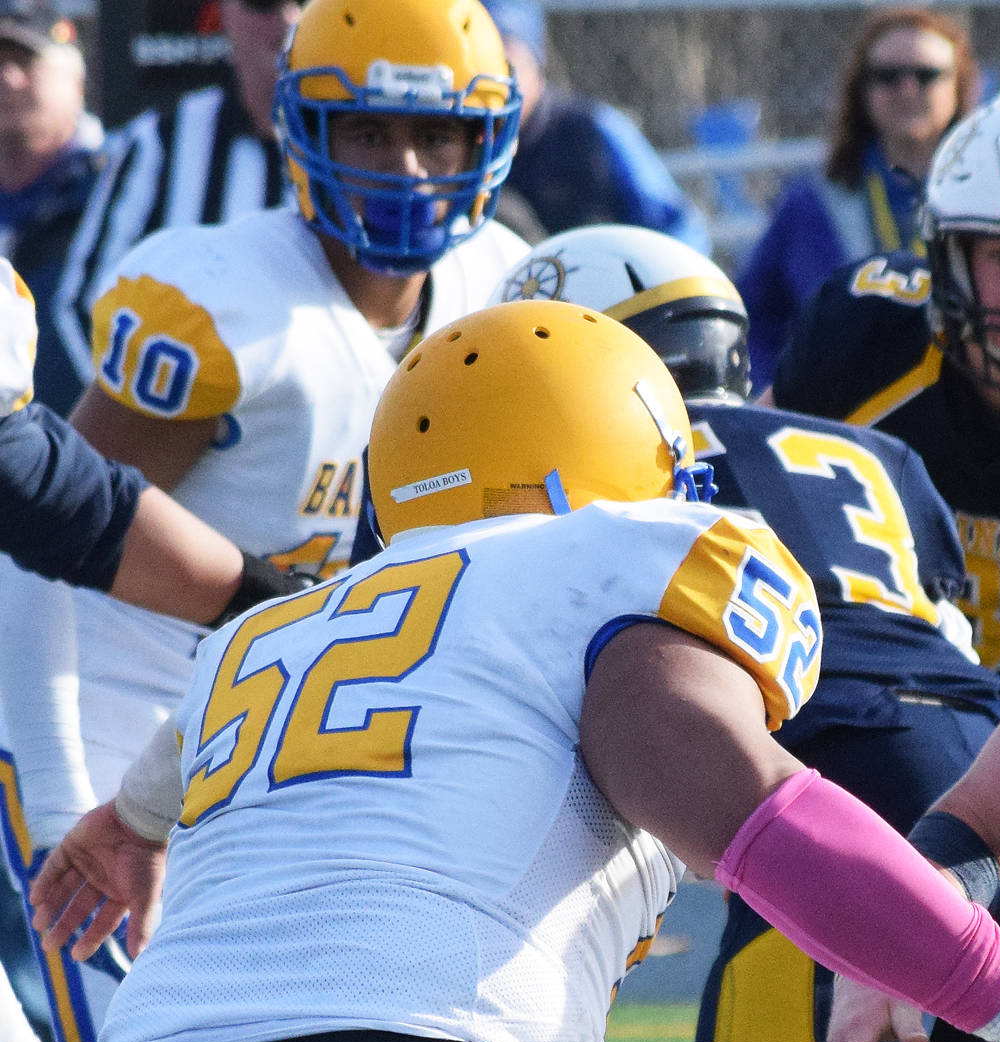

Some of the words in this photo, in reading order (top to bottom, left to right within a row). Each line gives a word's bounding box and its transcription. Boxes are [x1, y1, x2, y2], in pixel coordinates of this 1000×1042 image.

[100, 307, 199, 420] 10
[414, 478, 442, 495] TOLOA
[443, 472, 467, 486] BOYS
[177, 548, 471, 830] 52
[722, 545, 823, 720] 52
